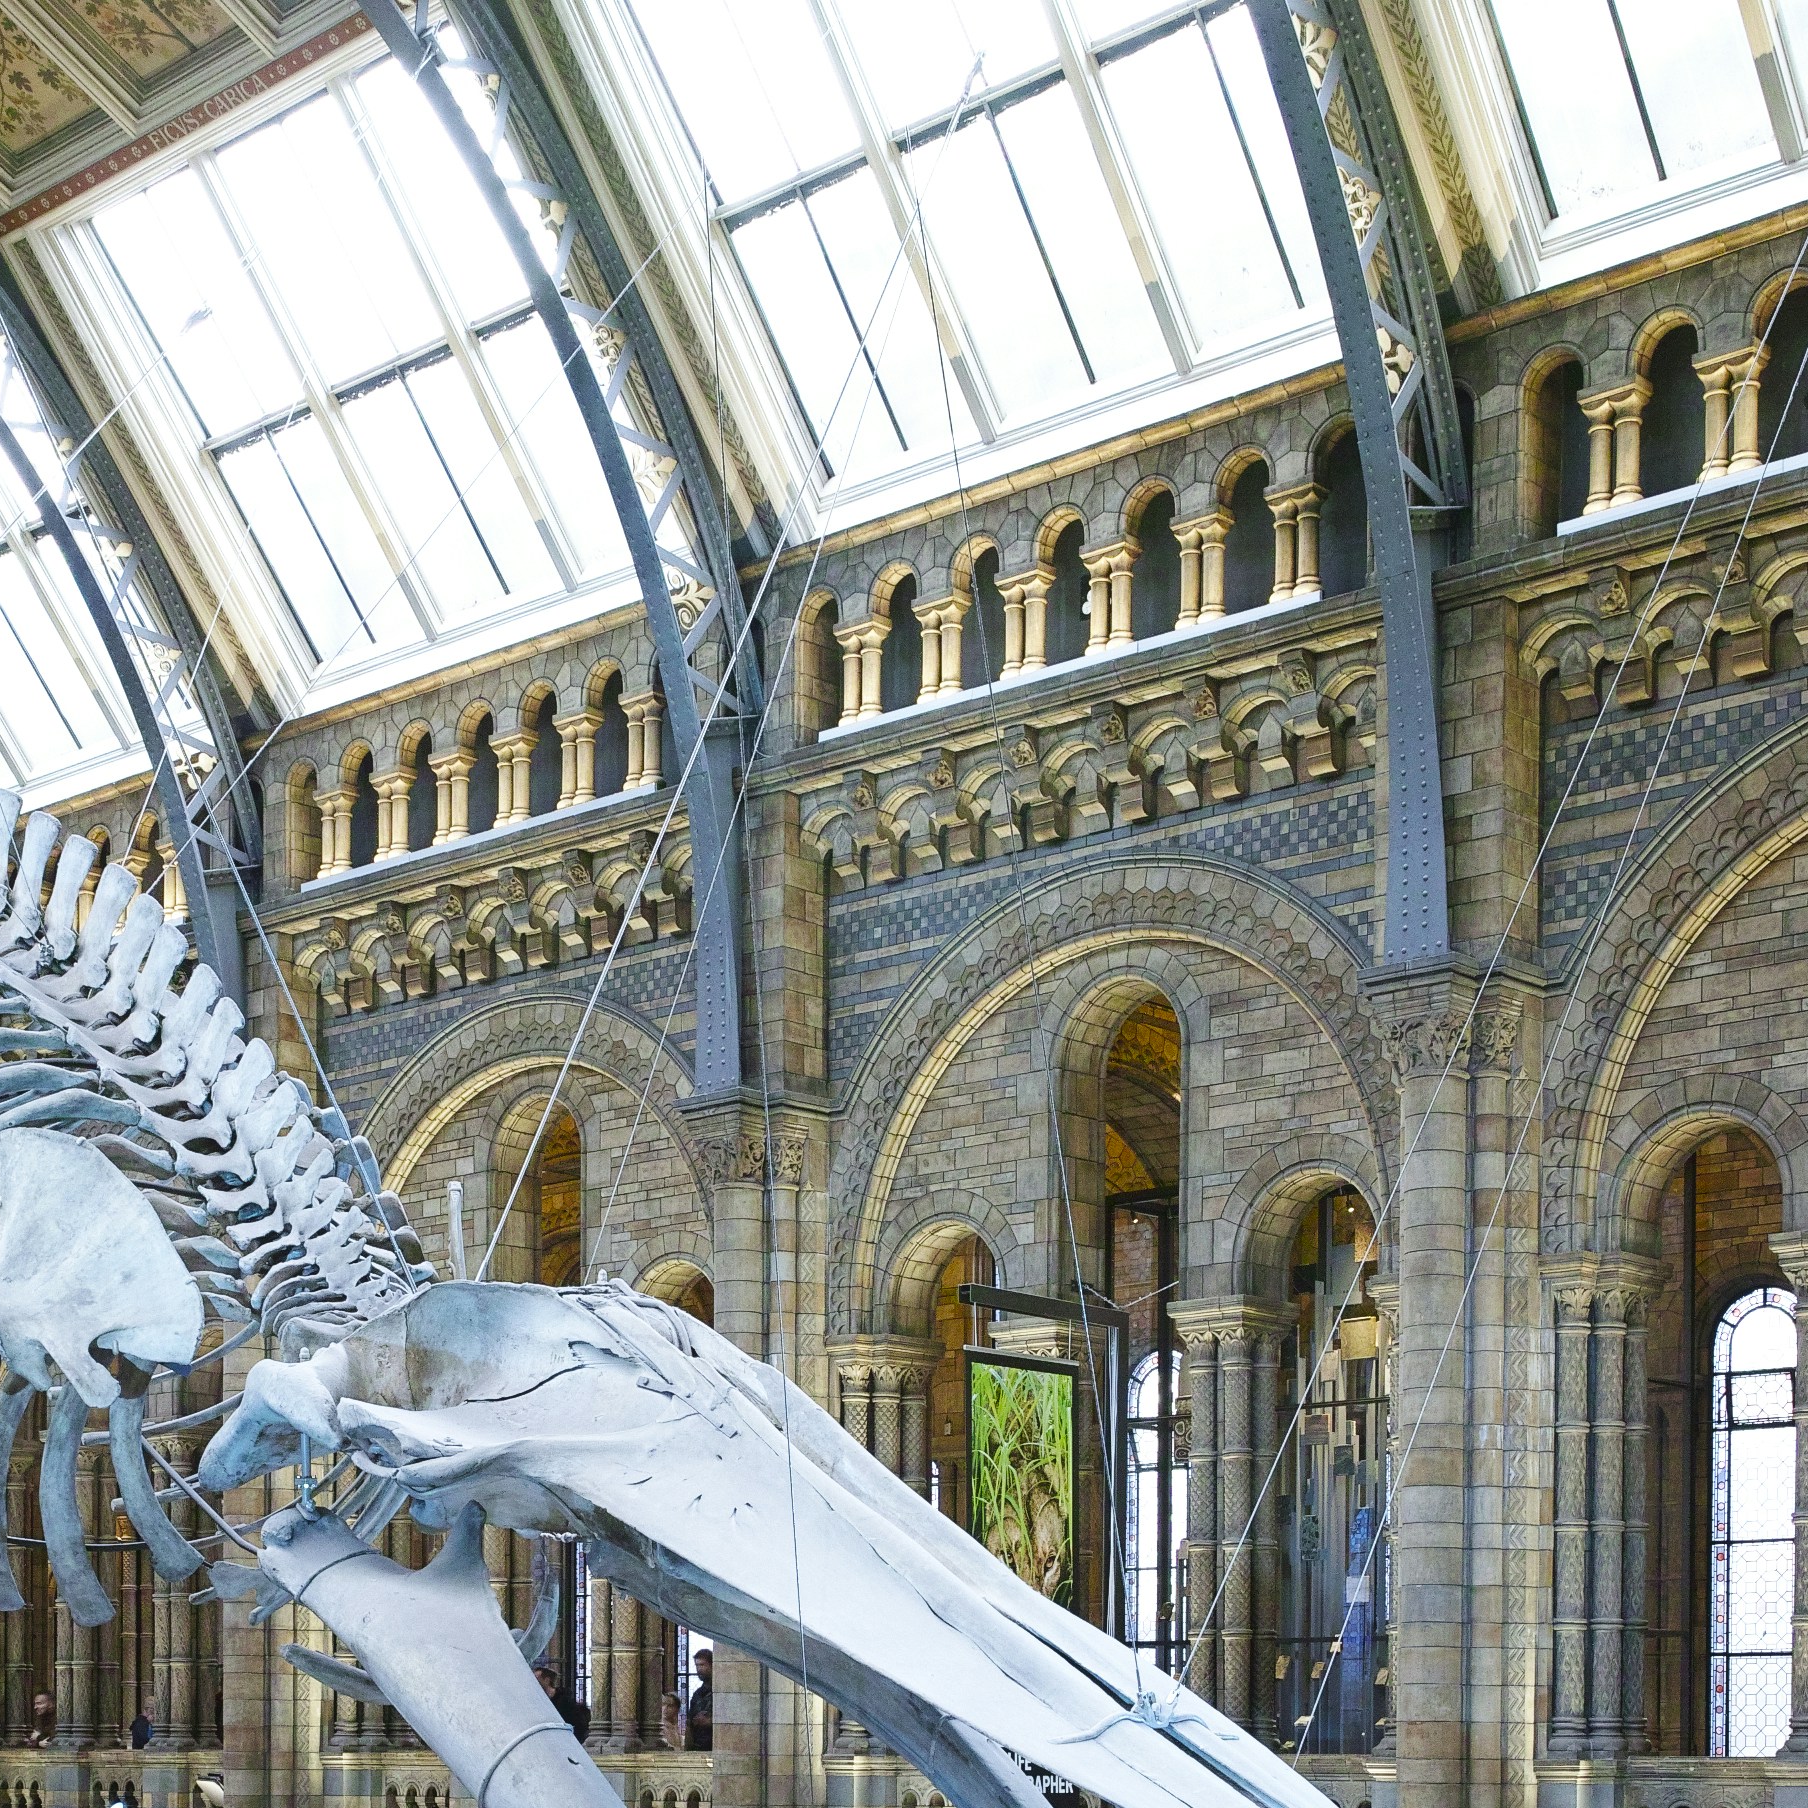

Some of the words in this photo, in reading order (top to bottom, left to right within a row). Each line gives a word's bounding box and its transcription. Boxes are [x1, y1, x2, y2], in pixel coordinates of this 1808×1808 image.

[148, 111, 200, 152] FICVS
[203, 75, 269, 120] CARICA
[1007, 1752, 1032, 1771] IFE
